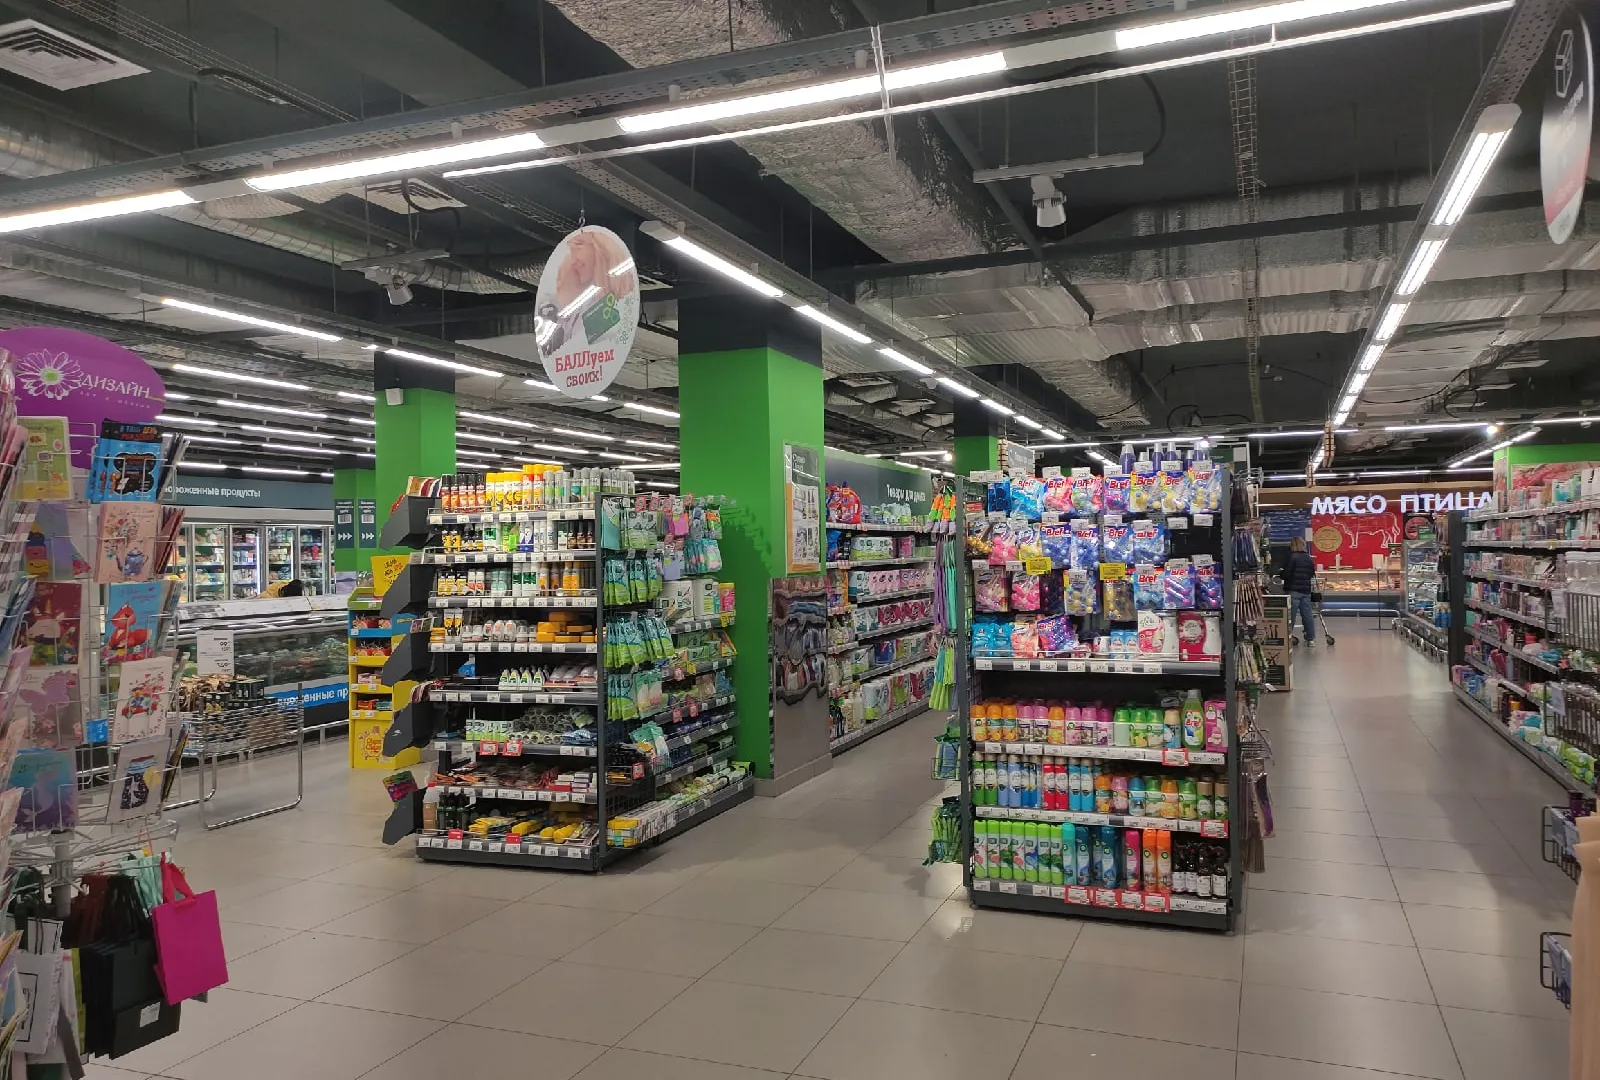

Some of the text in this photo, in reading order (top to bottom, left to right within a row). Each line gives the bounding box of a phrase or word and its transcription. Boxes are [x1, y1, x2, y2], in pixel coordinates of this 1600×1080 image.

[555, 349, 615, 373] БАЛЛуем
[566, 365, 603, 388] своих!
[82, 374, 151, 399] ДИЗАЙН
[1047, 480, 1066, 489] Bref
[1076, 479, 1094, 488] Bref
[1109, 479, 1129, 489] Bref
[1136, 477, 1157, 486] Bref
[164, 486, 261, 499] ооженные продукты
[886, 483, 905, 501] Товары
[1311, 493, 1387, 515] МЯСО
[1046, 527, 1065, 536] Bref
[1077, 530, 1093, 538] Bref
[1108, 528, 1128, 538] Bref
[1138, 574, 1158, 583] Bref
